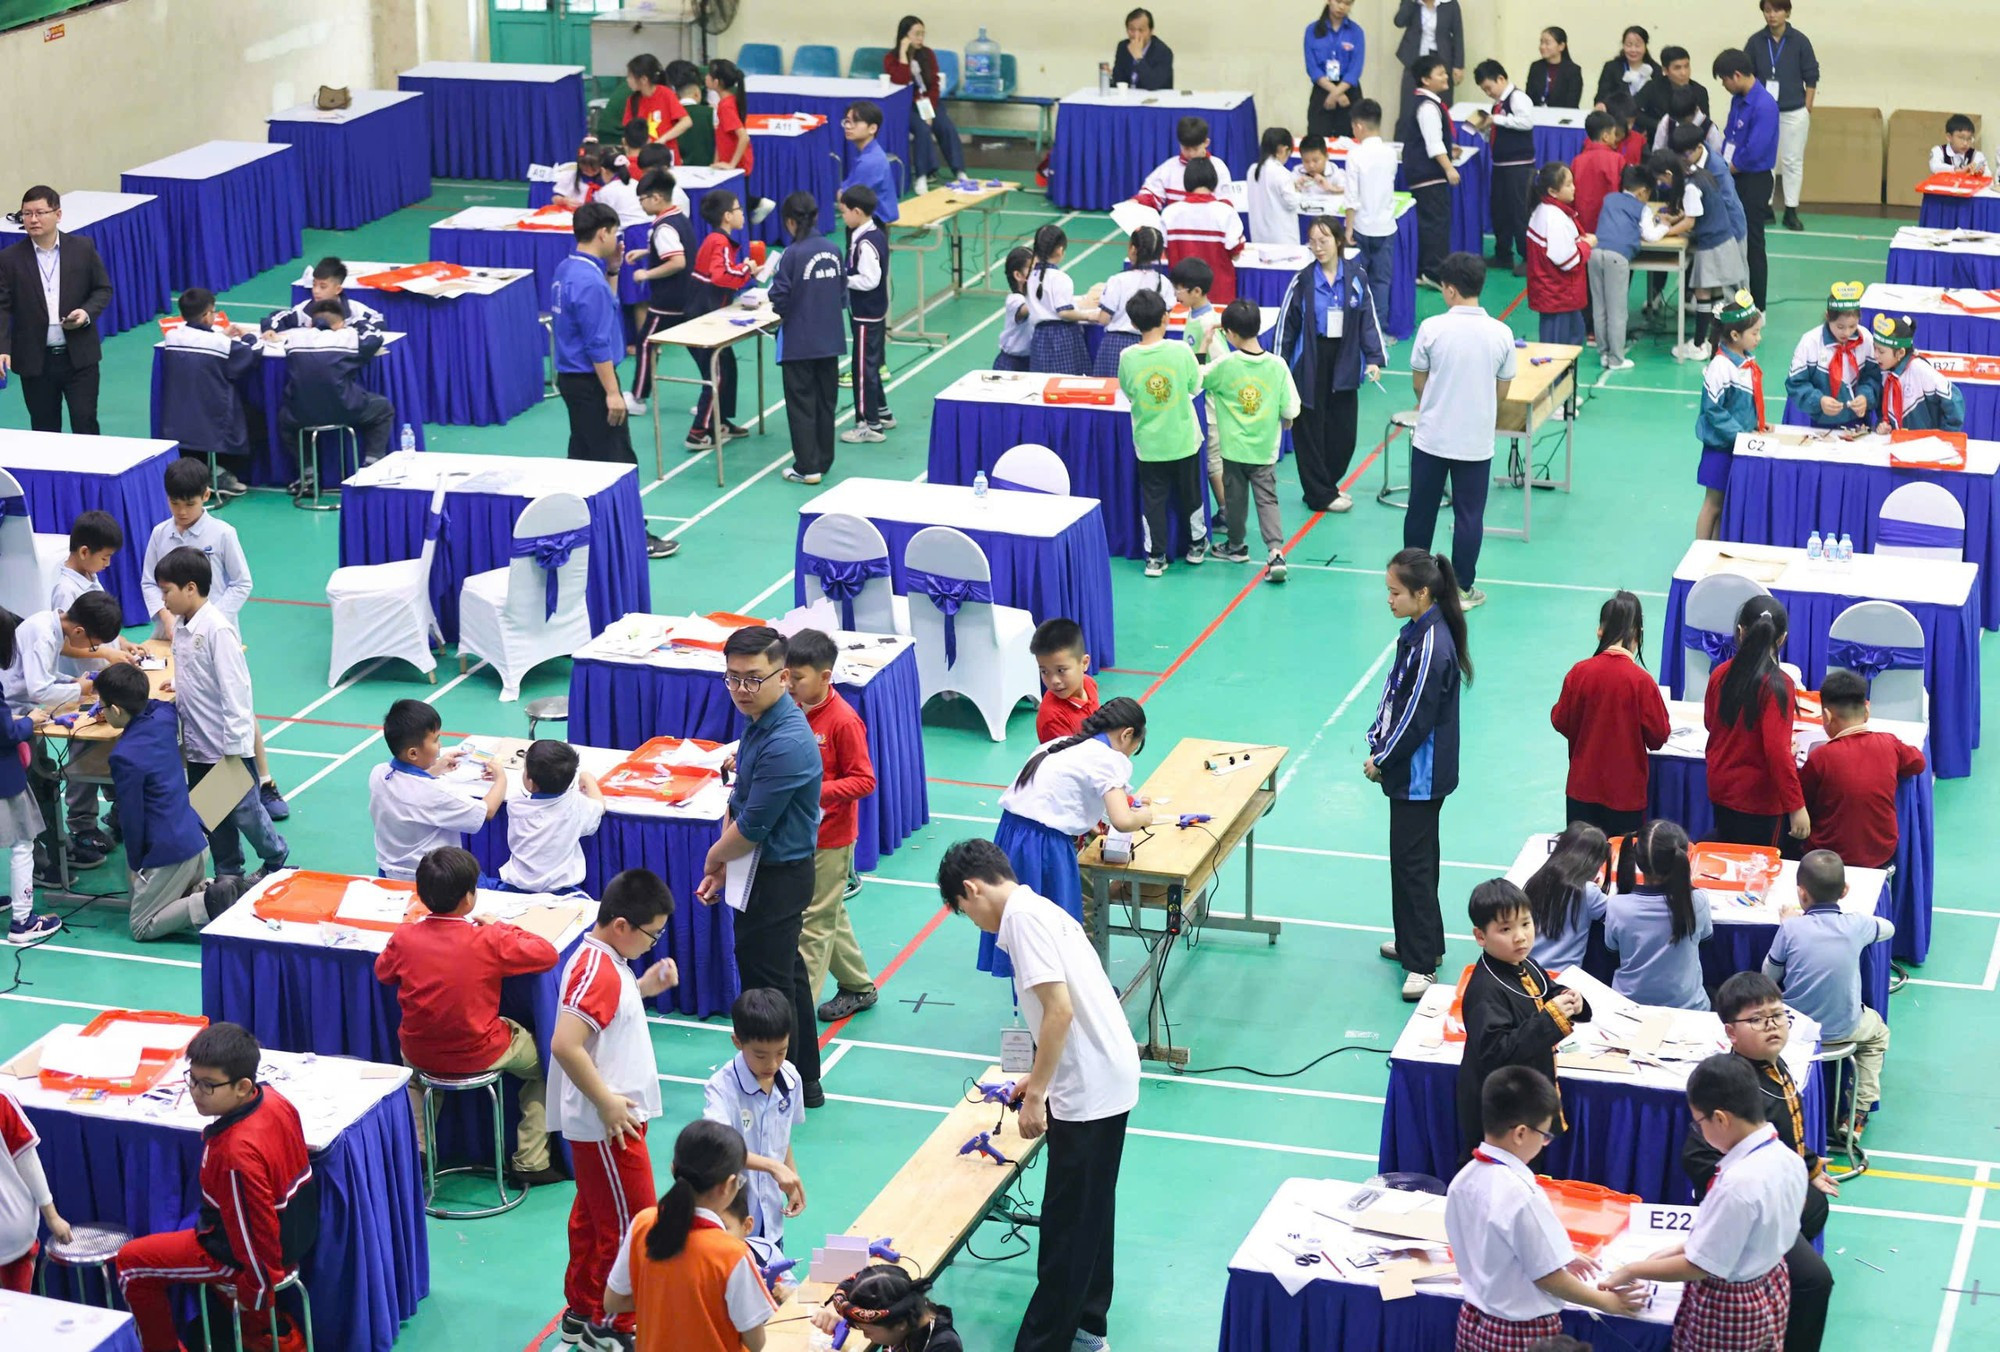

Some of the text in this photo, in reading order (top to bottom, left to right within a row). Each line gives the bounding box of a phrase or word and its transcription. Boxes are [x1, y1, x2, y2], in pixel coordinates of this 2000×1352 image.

[774, 122, 792, 131] A11
[1933, 361, 1955, 371] B27
[1747, 439, 1765, 452] C2
[1650, 1210, 1692, 1231] E22
